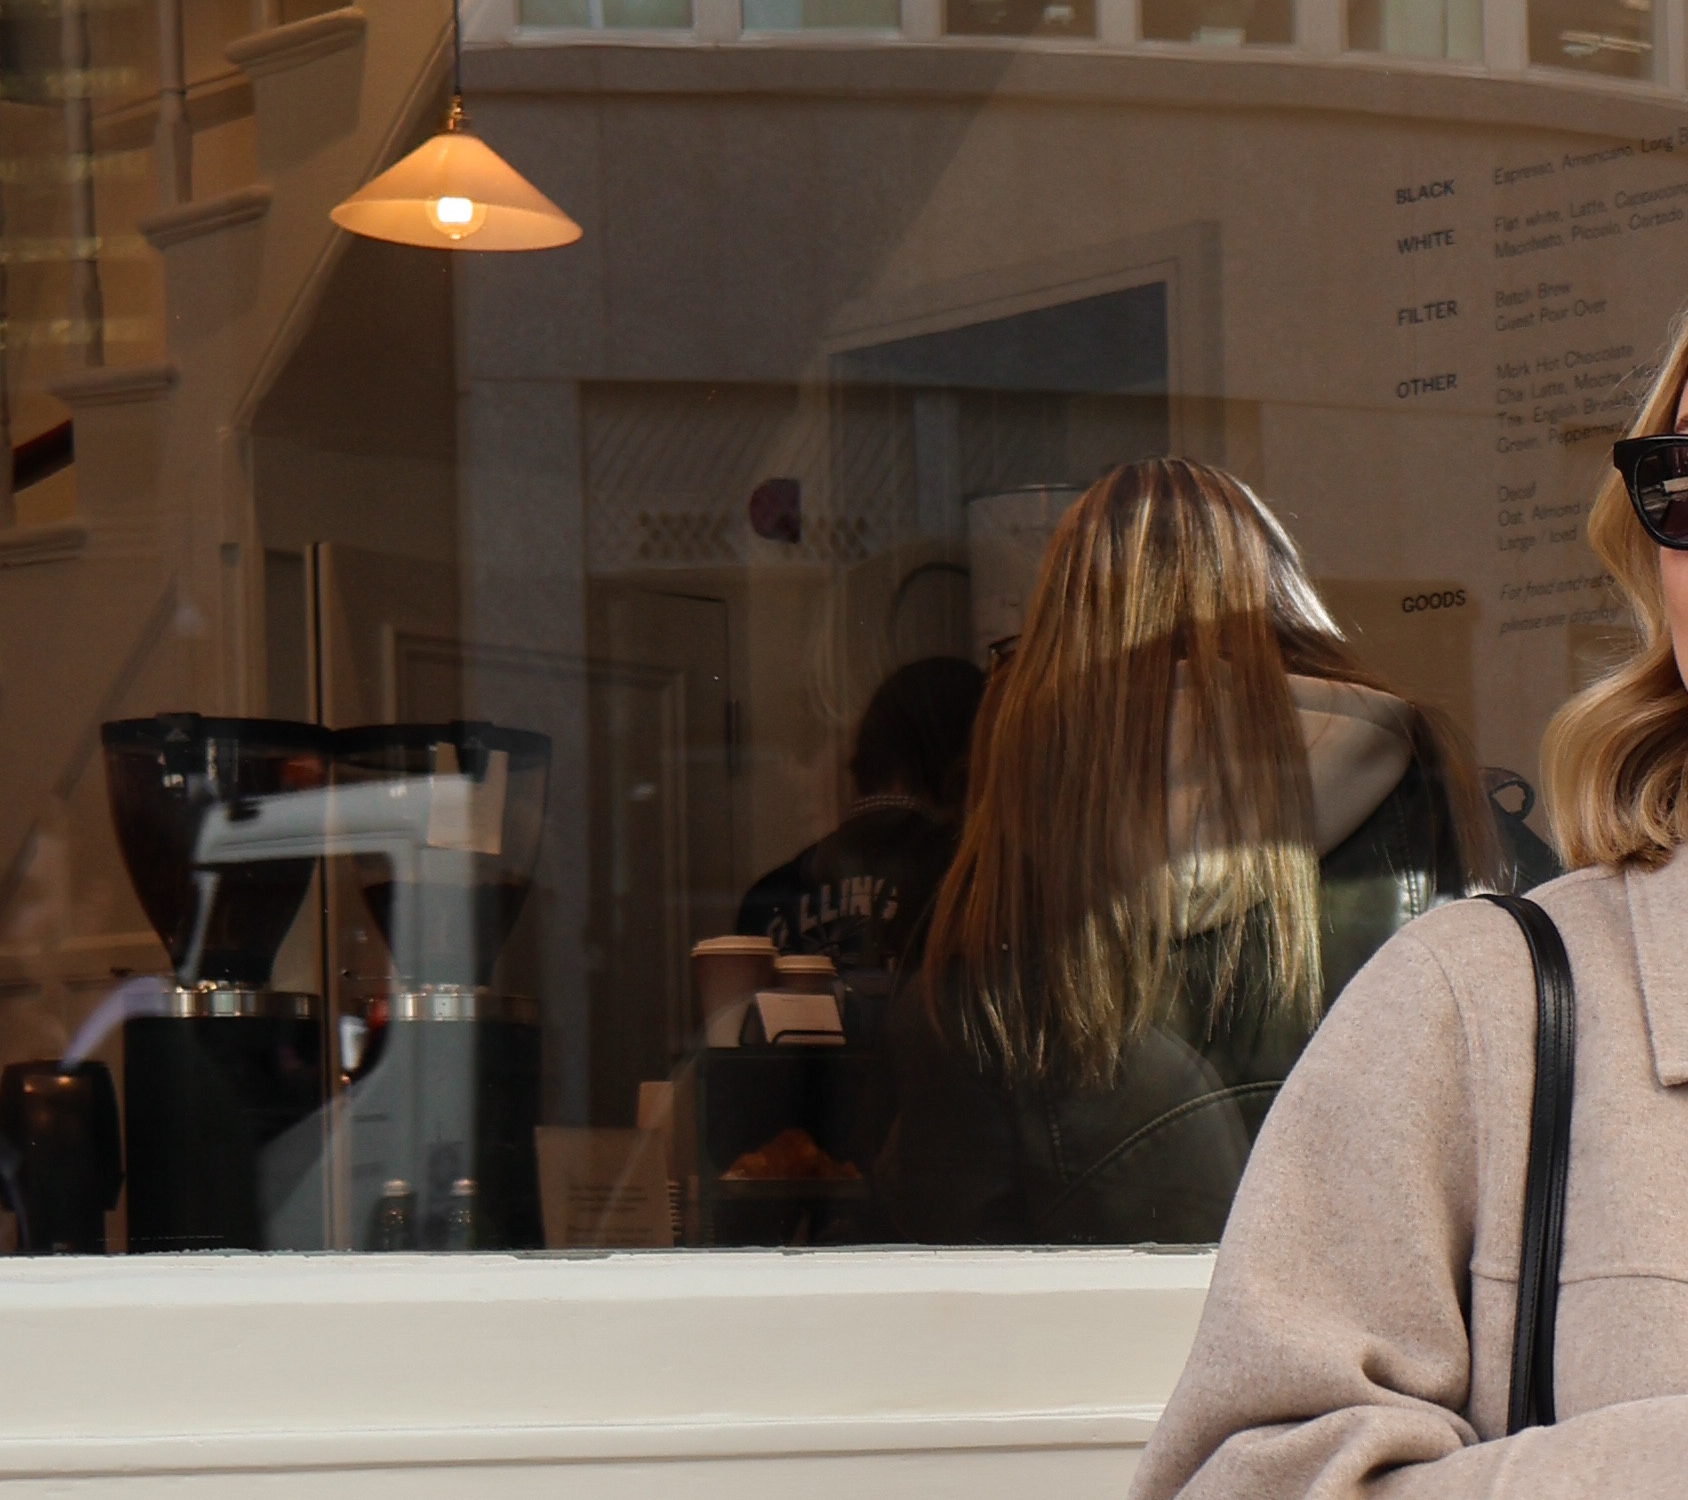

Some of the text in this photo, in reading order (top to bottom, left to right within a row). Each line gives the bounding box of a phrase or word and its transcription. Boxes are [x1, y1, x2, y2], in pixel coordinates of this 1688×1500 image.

[1395, 178, 1456, 206] BLACK
[1397, 229, 1456, 256] WHITE
[1395, 299, 1459, 327] FILTER
[1395, 372, 1458, 400] OTHER
[1402, 588, 1467, 614] GOODS
